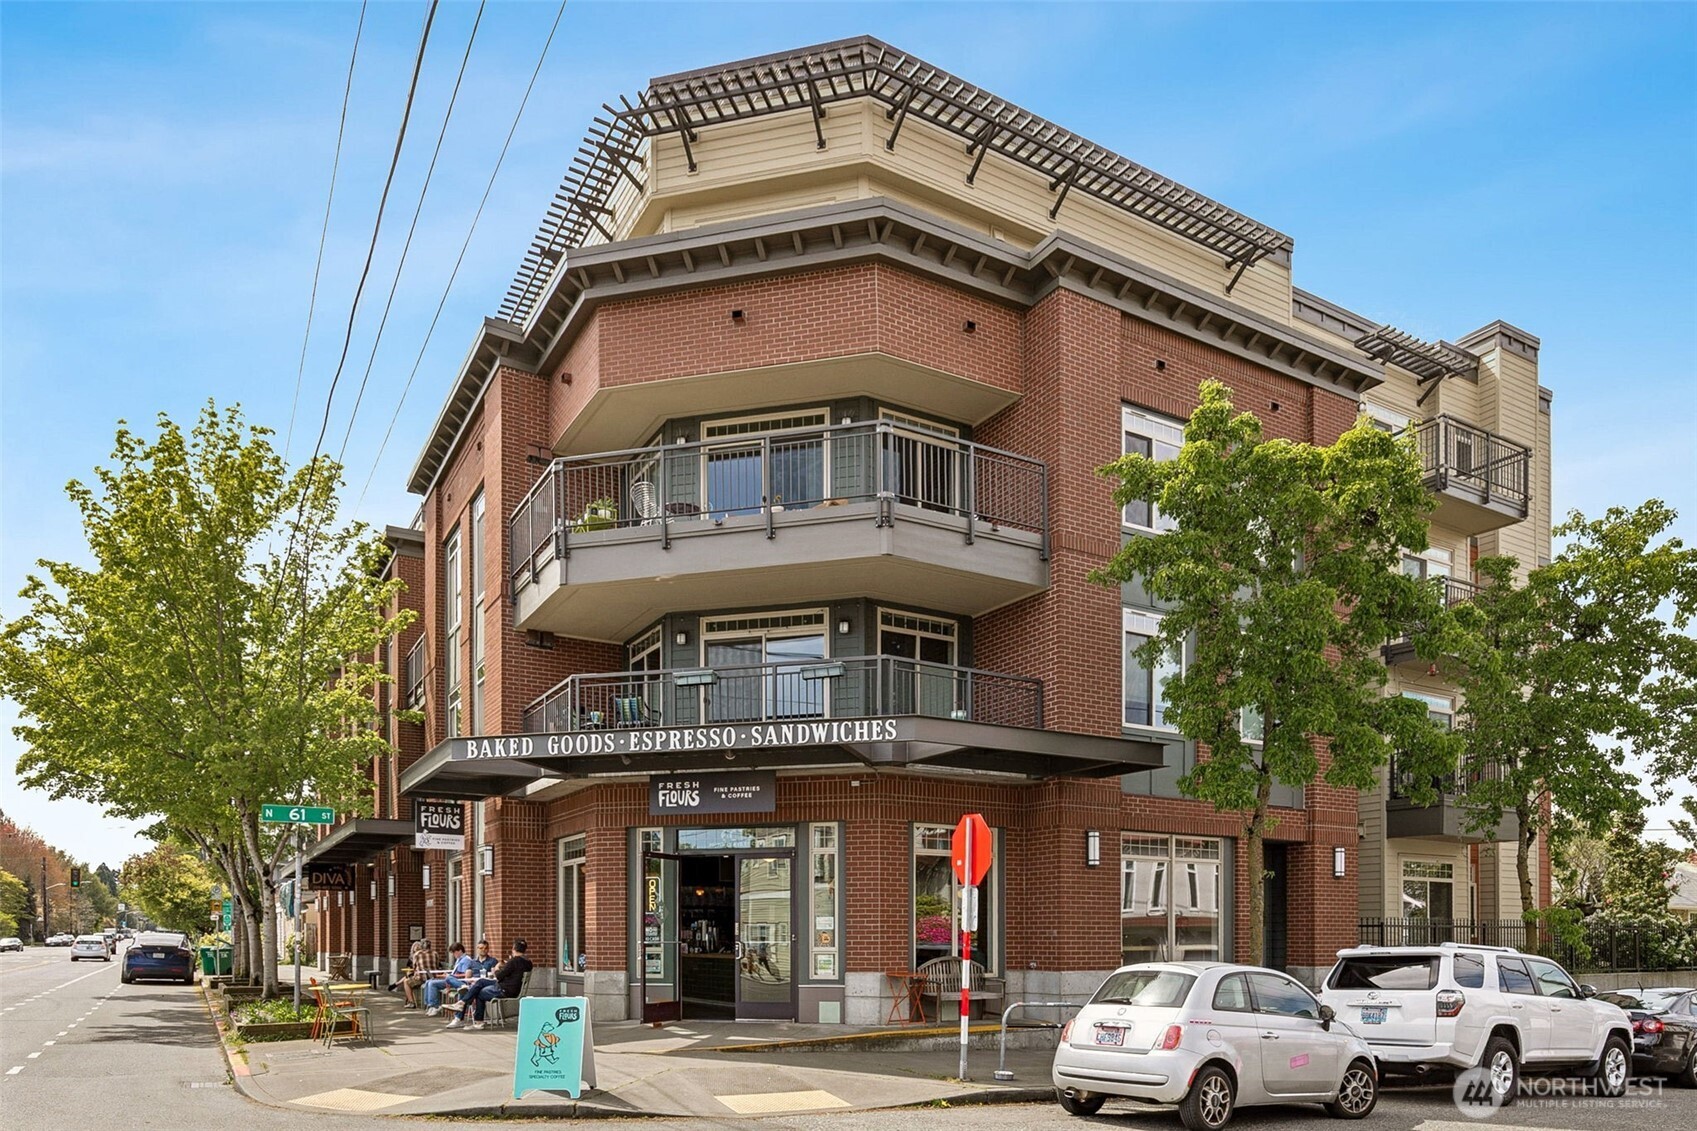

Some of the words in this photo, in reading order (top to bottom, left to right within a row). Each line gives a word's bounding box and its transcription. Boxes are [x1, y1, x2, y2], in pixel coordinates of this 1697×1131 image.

[466, 737, 533, 759] BAKED
[547, 733, 615, 755] GOODS
[629, 726, 736, 751] ESPRESSO
[751, 719, 898, 746] SANDWICHES
[658, 781, 699, 789] FRESH
[658, 790, 700, 807] FLOURS
[265, 808, 273, 818] N
[289, 808, 306, 821] 61
[321, 812, 331, 820] ST
[421, 805, 460, 814] FRESH
[420, 812, 461, 829] FLOURS
[312, 872, 345, 885] DIVA
[648, 879, 656, 912] OPEN
